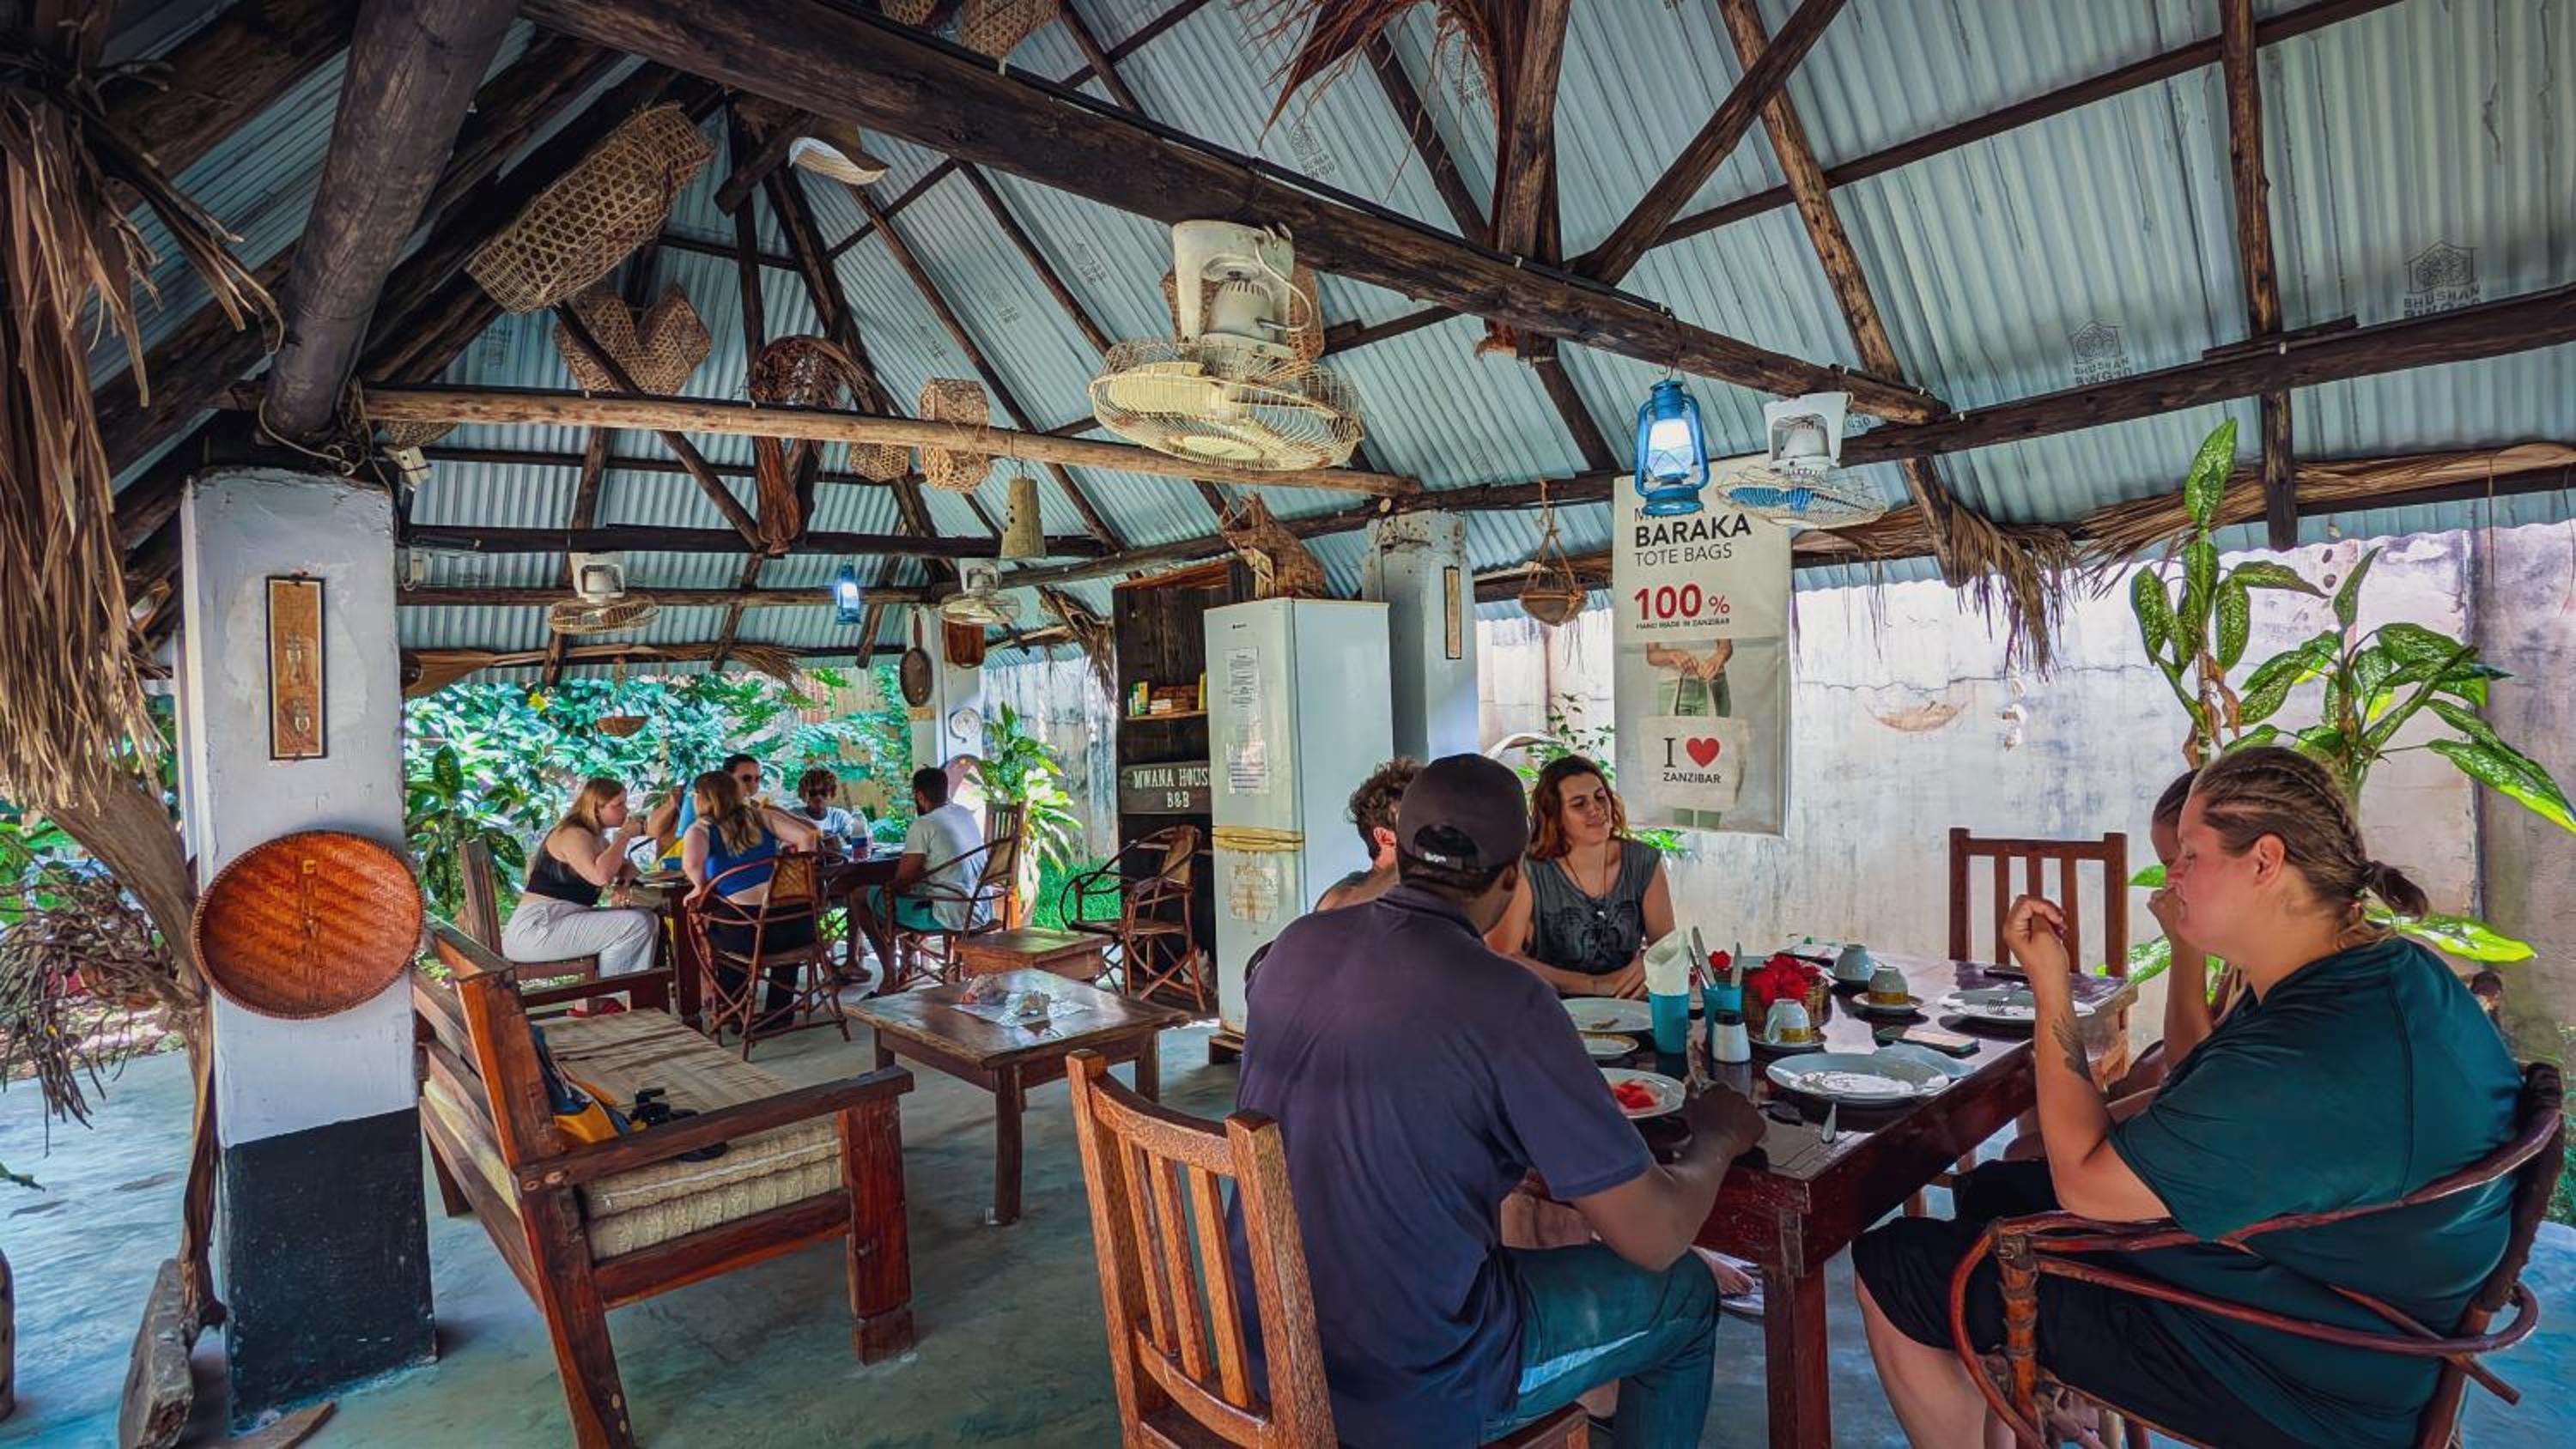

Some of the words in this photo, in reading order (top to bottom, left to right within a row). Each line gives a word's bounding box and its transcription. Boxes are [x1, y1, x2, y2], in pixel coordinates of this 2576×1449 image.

[1635, 512, 1752, 548] BARAKA
[1635, 549, 1679, 567] TOTE
[1684, 543, 1732, 562] BAGS
[1634, 583, 1702, 620] 100
[1663, 737, 1677, 768] I
[1133, 768, 1175, 789] MWANA
[1179, 767, 1210, 787] HOUS
[1663, 772, 1721, 784] ZANZIBAR
[1167, 791, 1189, 808] B&B
